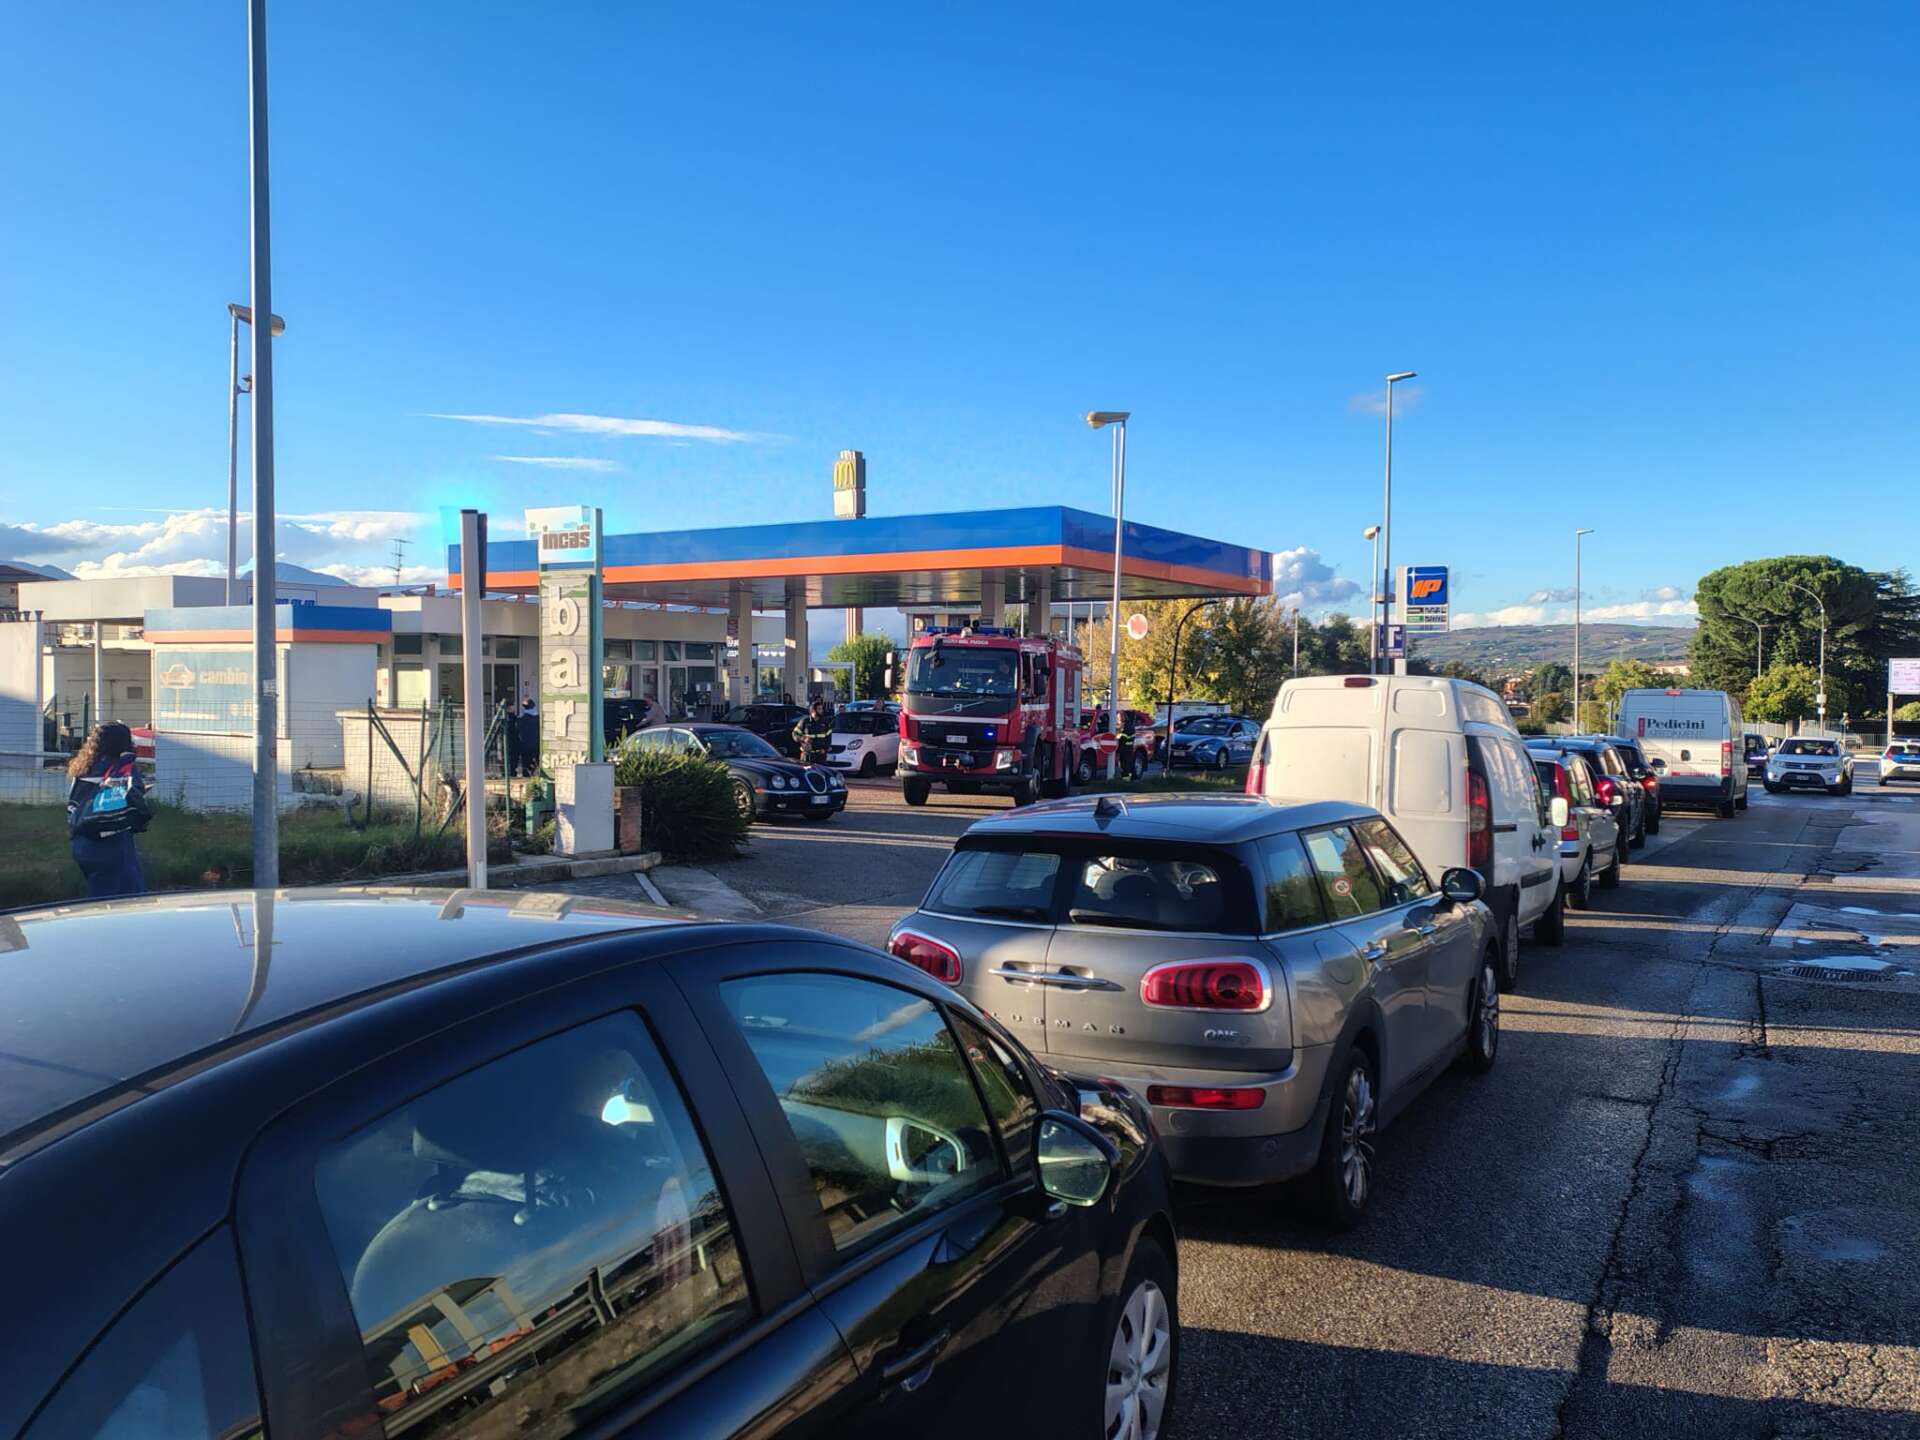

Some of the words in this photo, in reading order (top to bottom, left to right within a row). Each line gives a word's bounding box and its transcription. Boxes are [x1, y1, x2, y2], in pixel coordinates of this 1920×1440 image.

[542, 525, 590, 549] incas
[1411, 579, 1441, 597] IP
[549, 586, 580, 737] bar
[1647, 718, 1705, 730] Pedicini
[542, 751, 587, 769] snack
[992, 1011, 1125, 1034] LUBMAN
